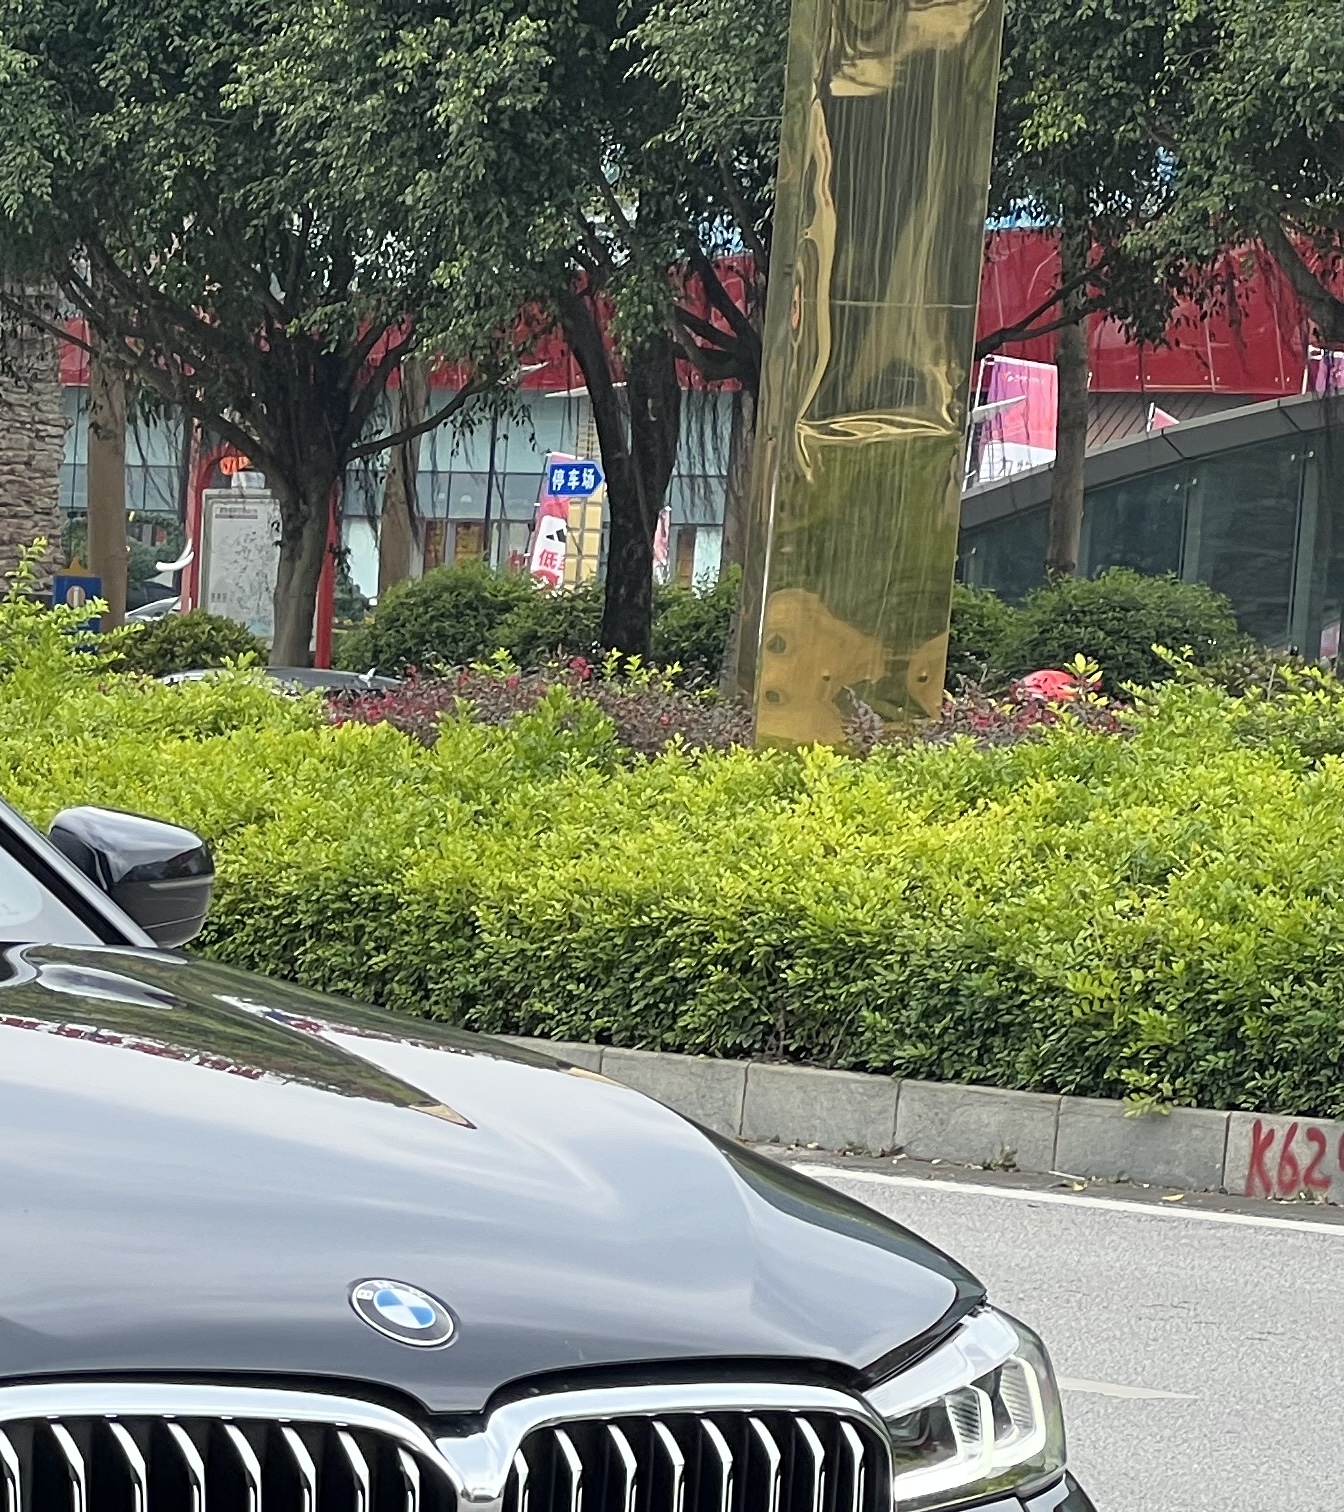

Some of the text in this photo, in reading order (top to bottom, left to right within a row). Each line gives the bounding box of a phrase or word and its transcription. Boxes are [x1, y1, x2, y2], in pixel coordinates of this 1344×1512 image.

[552, 468, 595, 491] 停车场
[1244, 1119, 1344, 1198] K62
